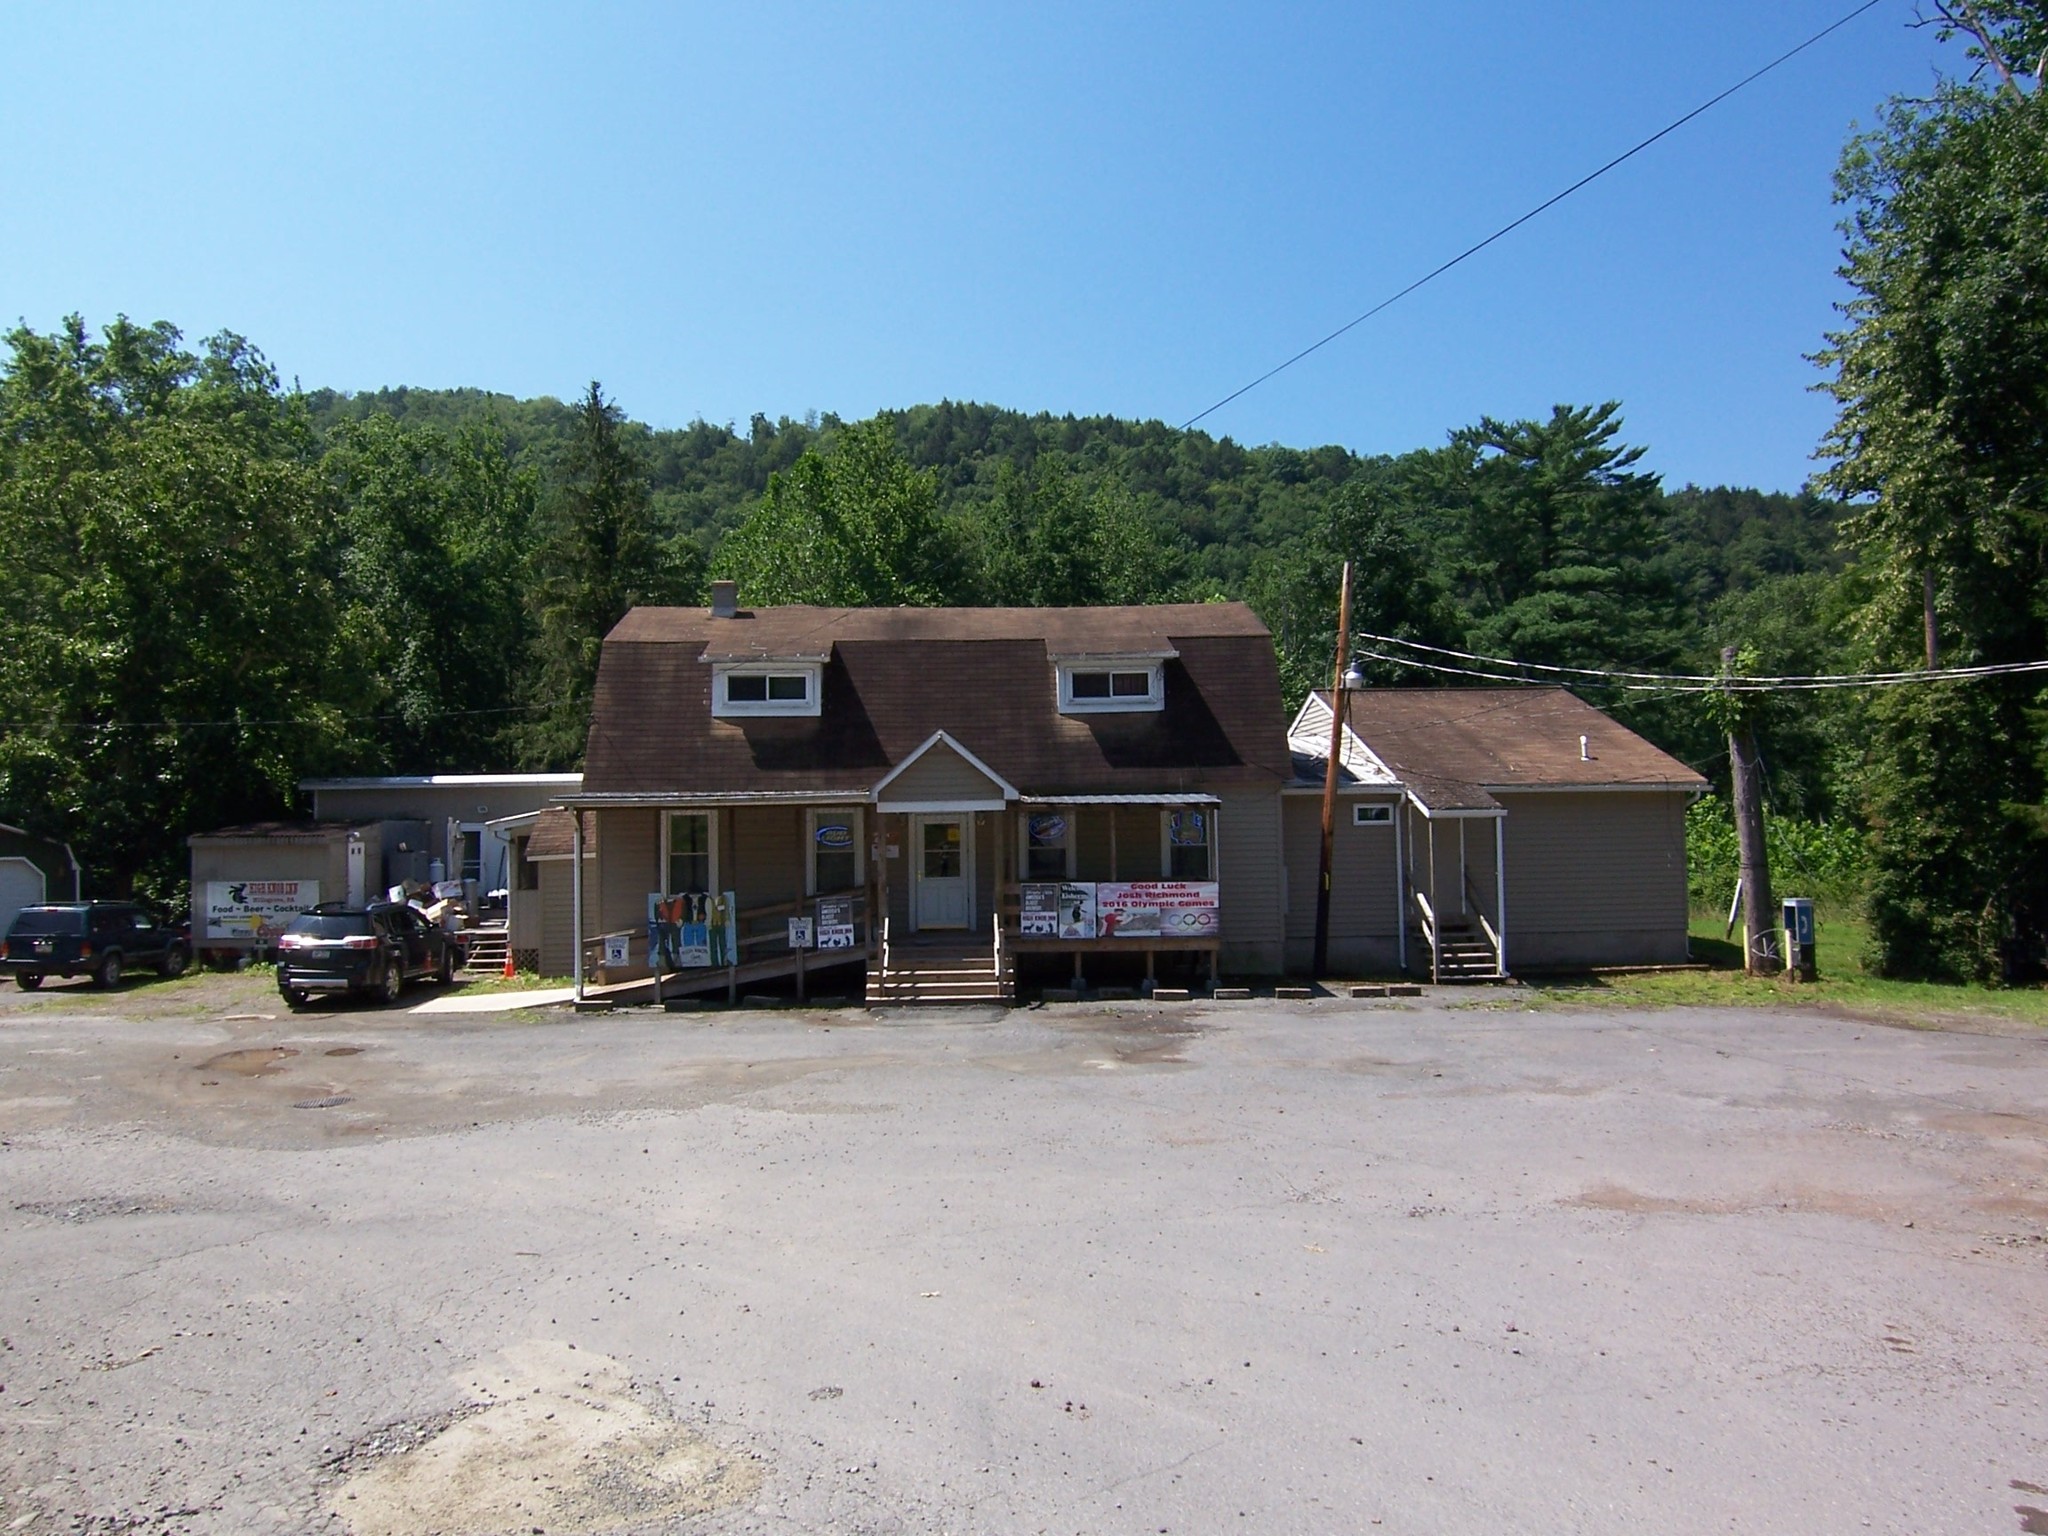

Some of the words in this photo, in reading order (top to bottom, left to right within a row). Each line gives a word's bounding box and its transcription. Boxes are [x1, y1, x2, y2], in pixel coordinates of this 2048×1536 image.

[1145, 891, 1200, 899] Richmond
[212, 905, 233, 913] Food
[1131, 901, 1176, 909] Olympic
